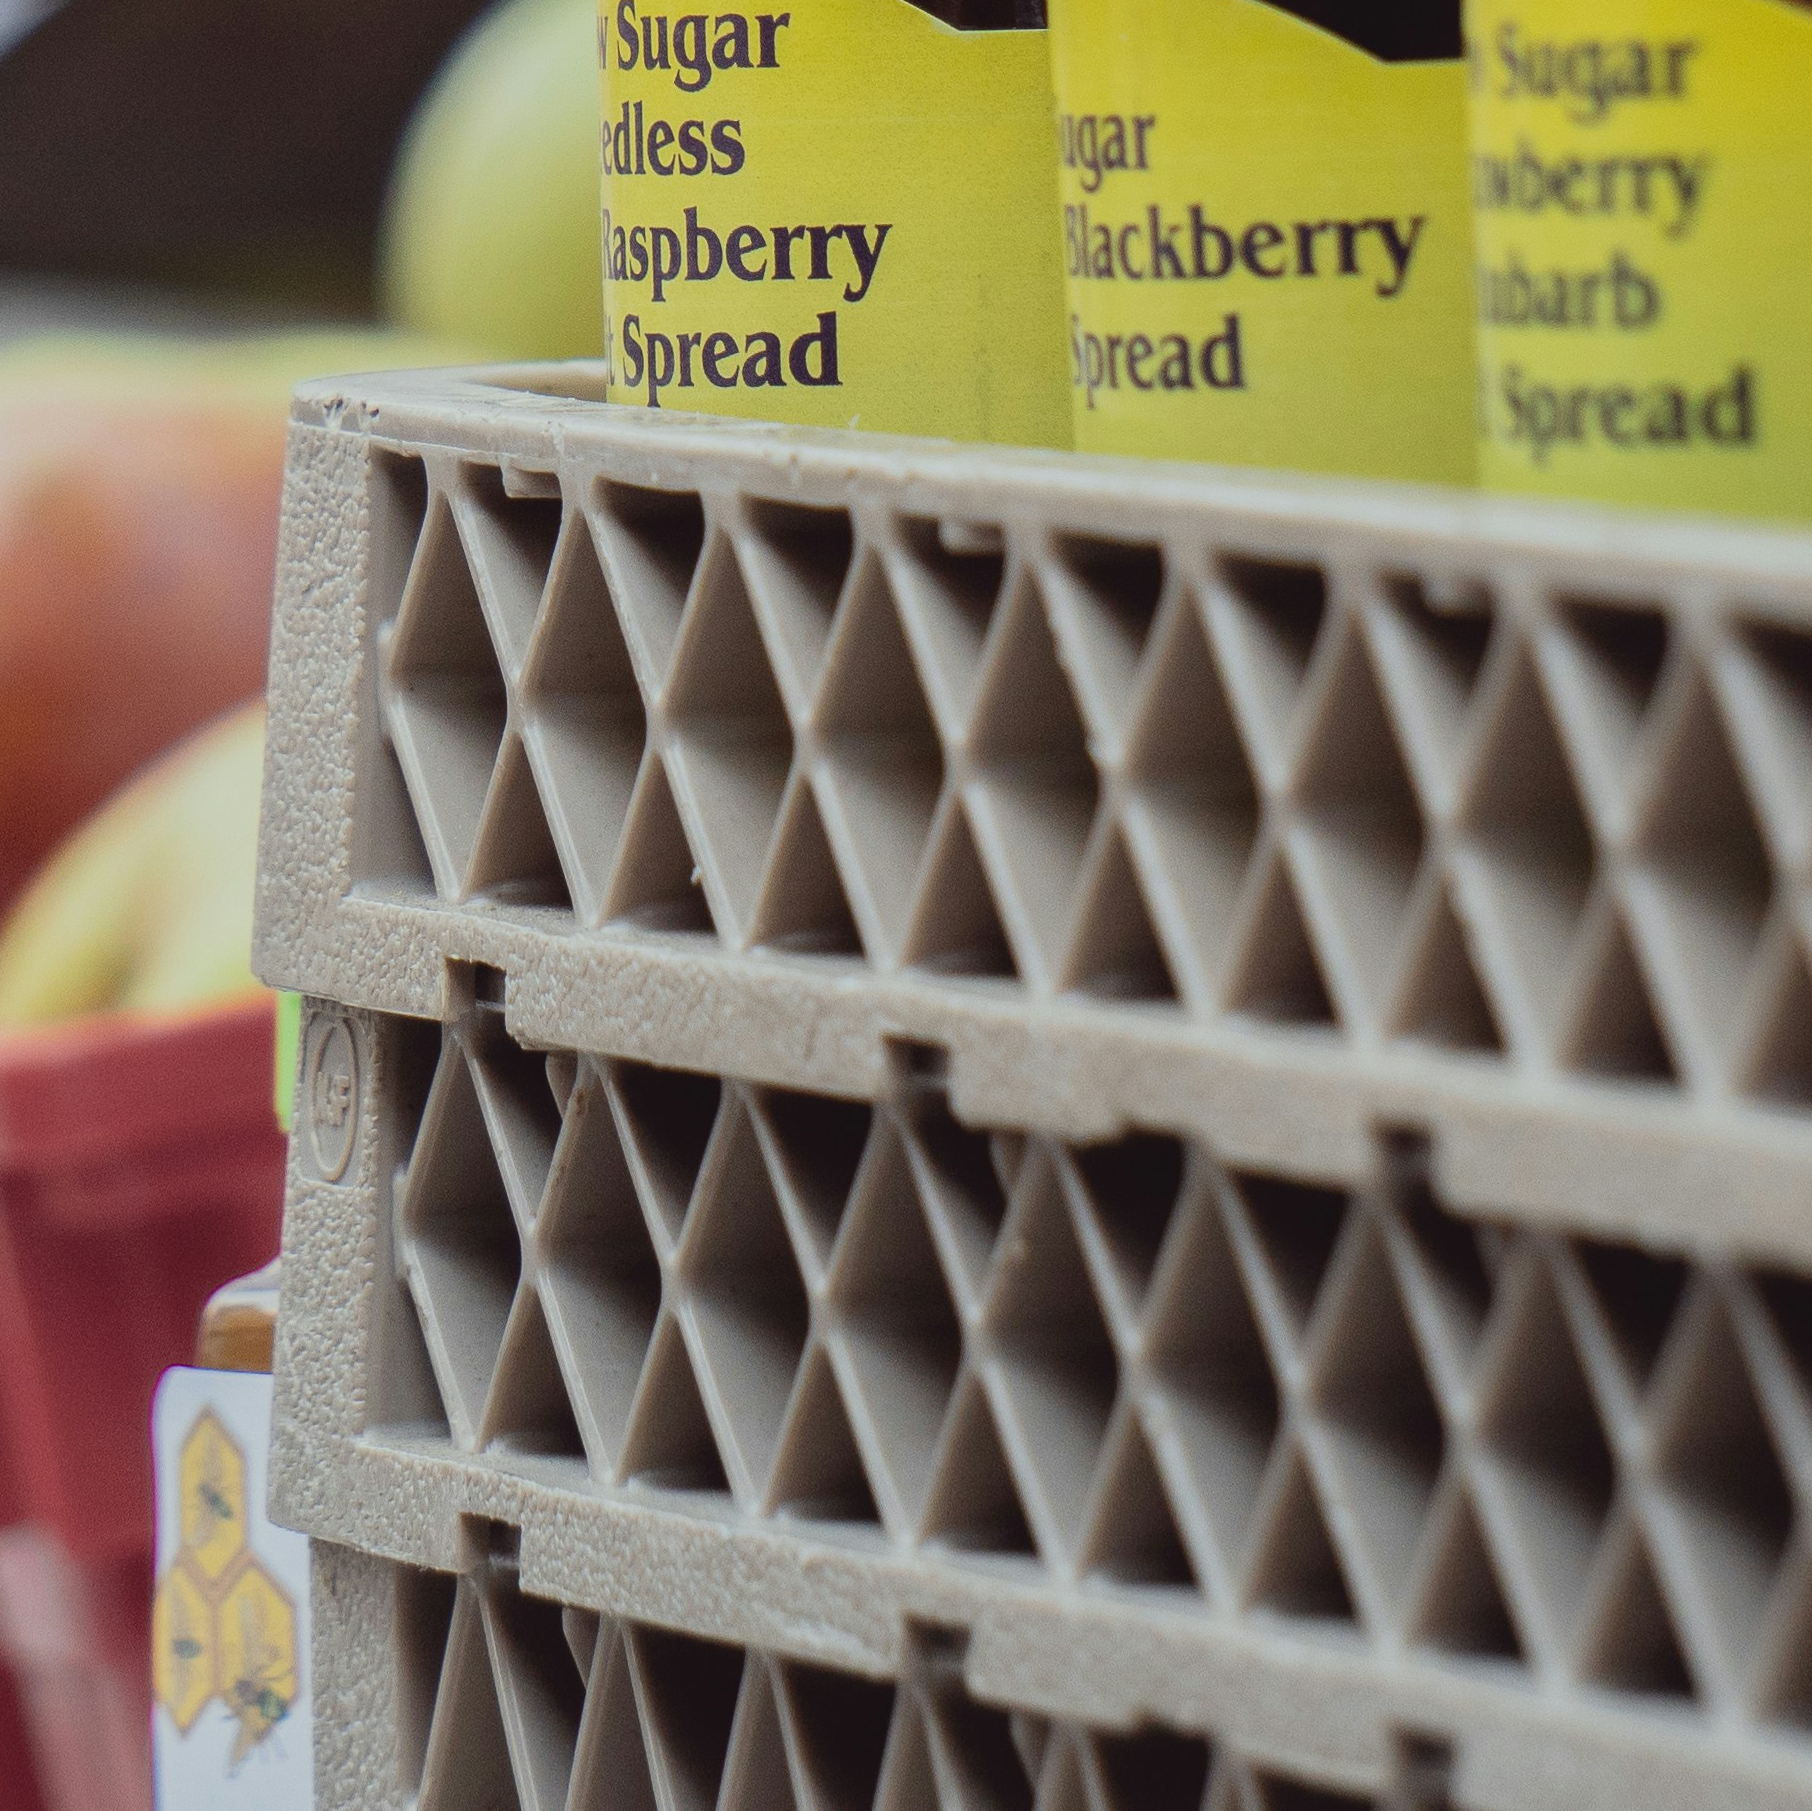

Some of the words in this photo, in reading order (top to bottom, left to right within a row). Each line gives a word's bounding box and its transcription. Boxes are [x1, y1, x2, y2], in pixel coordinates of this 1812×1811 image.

[1495, 21, 1702, 124] Sugar
[622, 311, 843, 408] Spread
[1500, 363, 1756, 466] Spread
